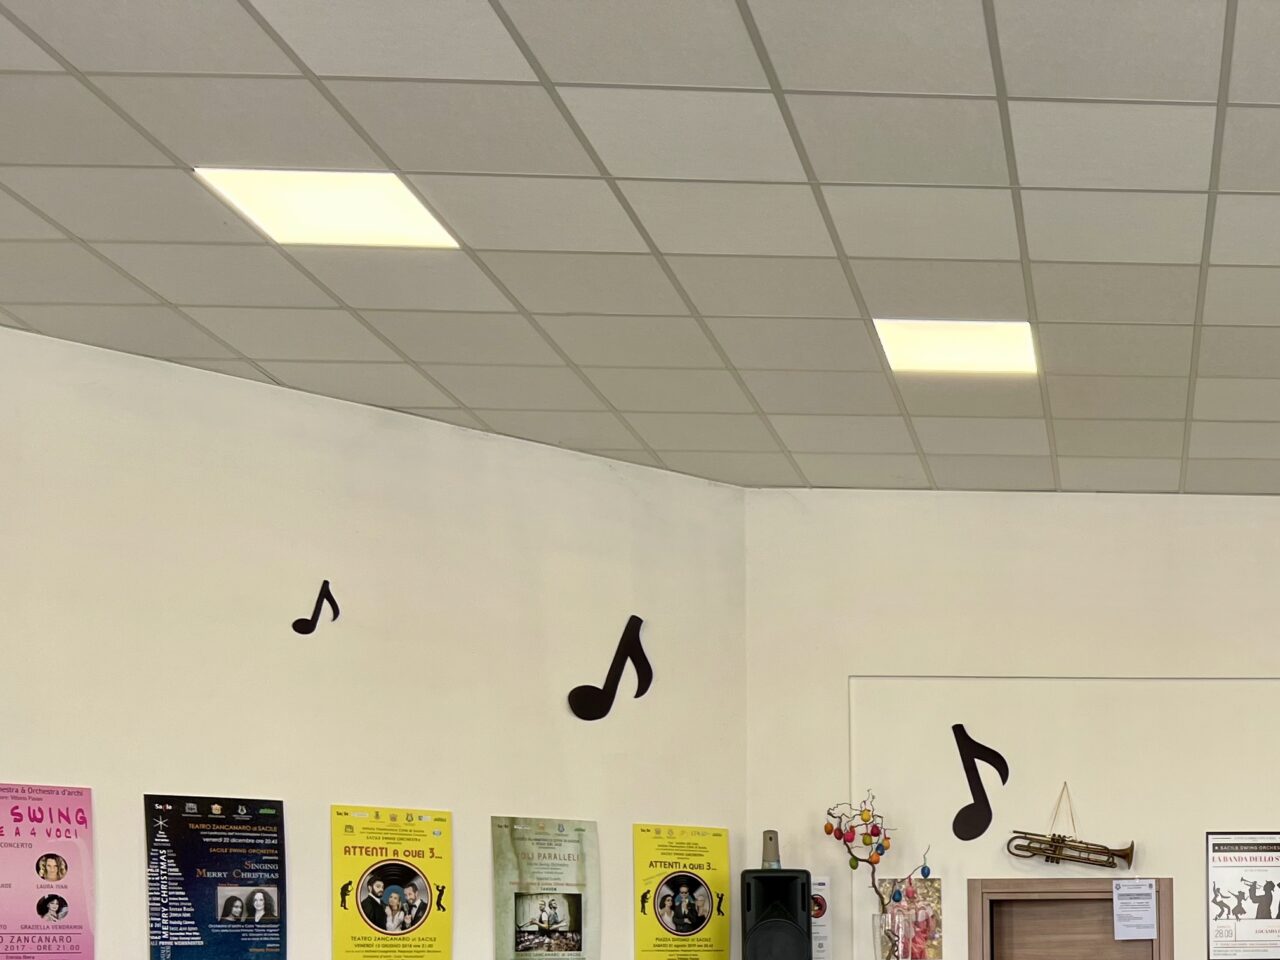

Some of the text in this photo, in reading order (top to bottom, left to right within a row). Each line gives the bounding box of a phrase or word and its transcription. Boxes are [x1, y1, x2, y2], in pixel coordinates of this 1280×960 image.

[28, 787, 59, 795] Orchestra
[10, 805, 87, 829] SWING
[15, 826, 20, 836] A
[30, 827, 36, 837] 4
[46, 828, 78, 839] VOCI
[344, 846, 388, 857] ATTENTI
[393, 849, 399, 857] A
[244, 860, 278, 870] SINGING
[649, 860, 680, 869] ATTENTI
[160, 850, 168, 904] CHRISTMAS
[196, 868, 279, 879] MERRY CHRISTMAS
